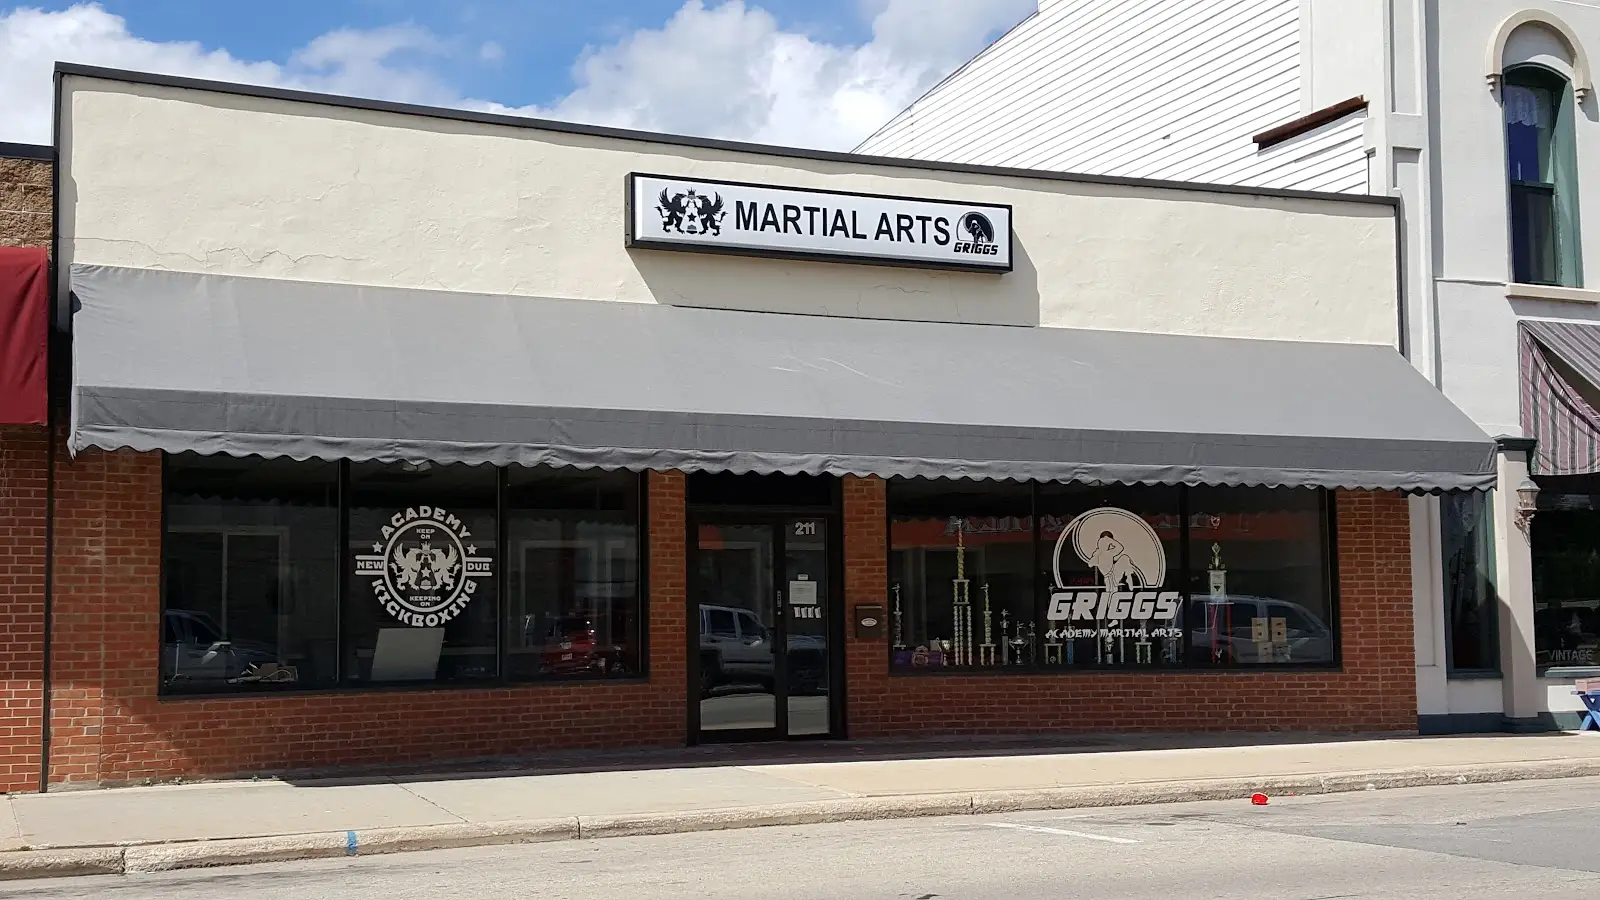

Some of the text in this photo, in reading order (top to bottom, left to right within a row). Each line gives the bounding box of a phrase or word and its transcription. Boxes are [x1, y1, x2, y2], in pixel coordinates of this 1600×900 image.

[735, 200, 951, 246] MARTIAL ARTS
[953, 241, 999, 256] GRIGGS
[381, 505, 471, 540] ACADEMY
[795, 522, 816, 535] 211
[356, 560, 384, 569] NEW
[372, 579, 477, 627] KICKBOXING
[1047, 591, 1180, 621] GRIGGS
[1045, 628, 1183, 639] ACADEMY MARTIAL ARTS
[1548, 649, 1593, 661] VINTAGE
